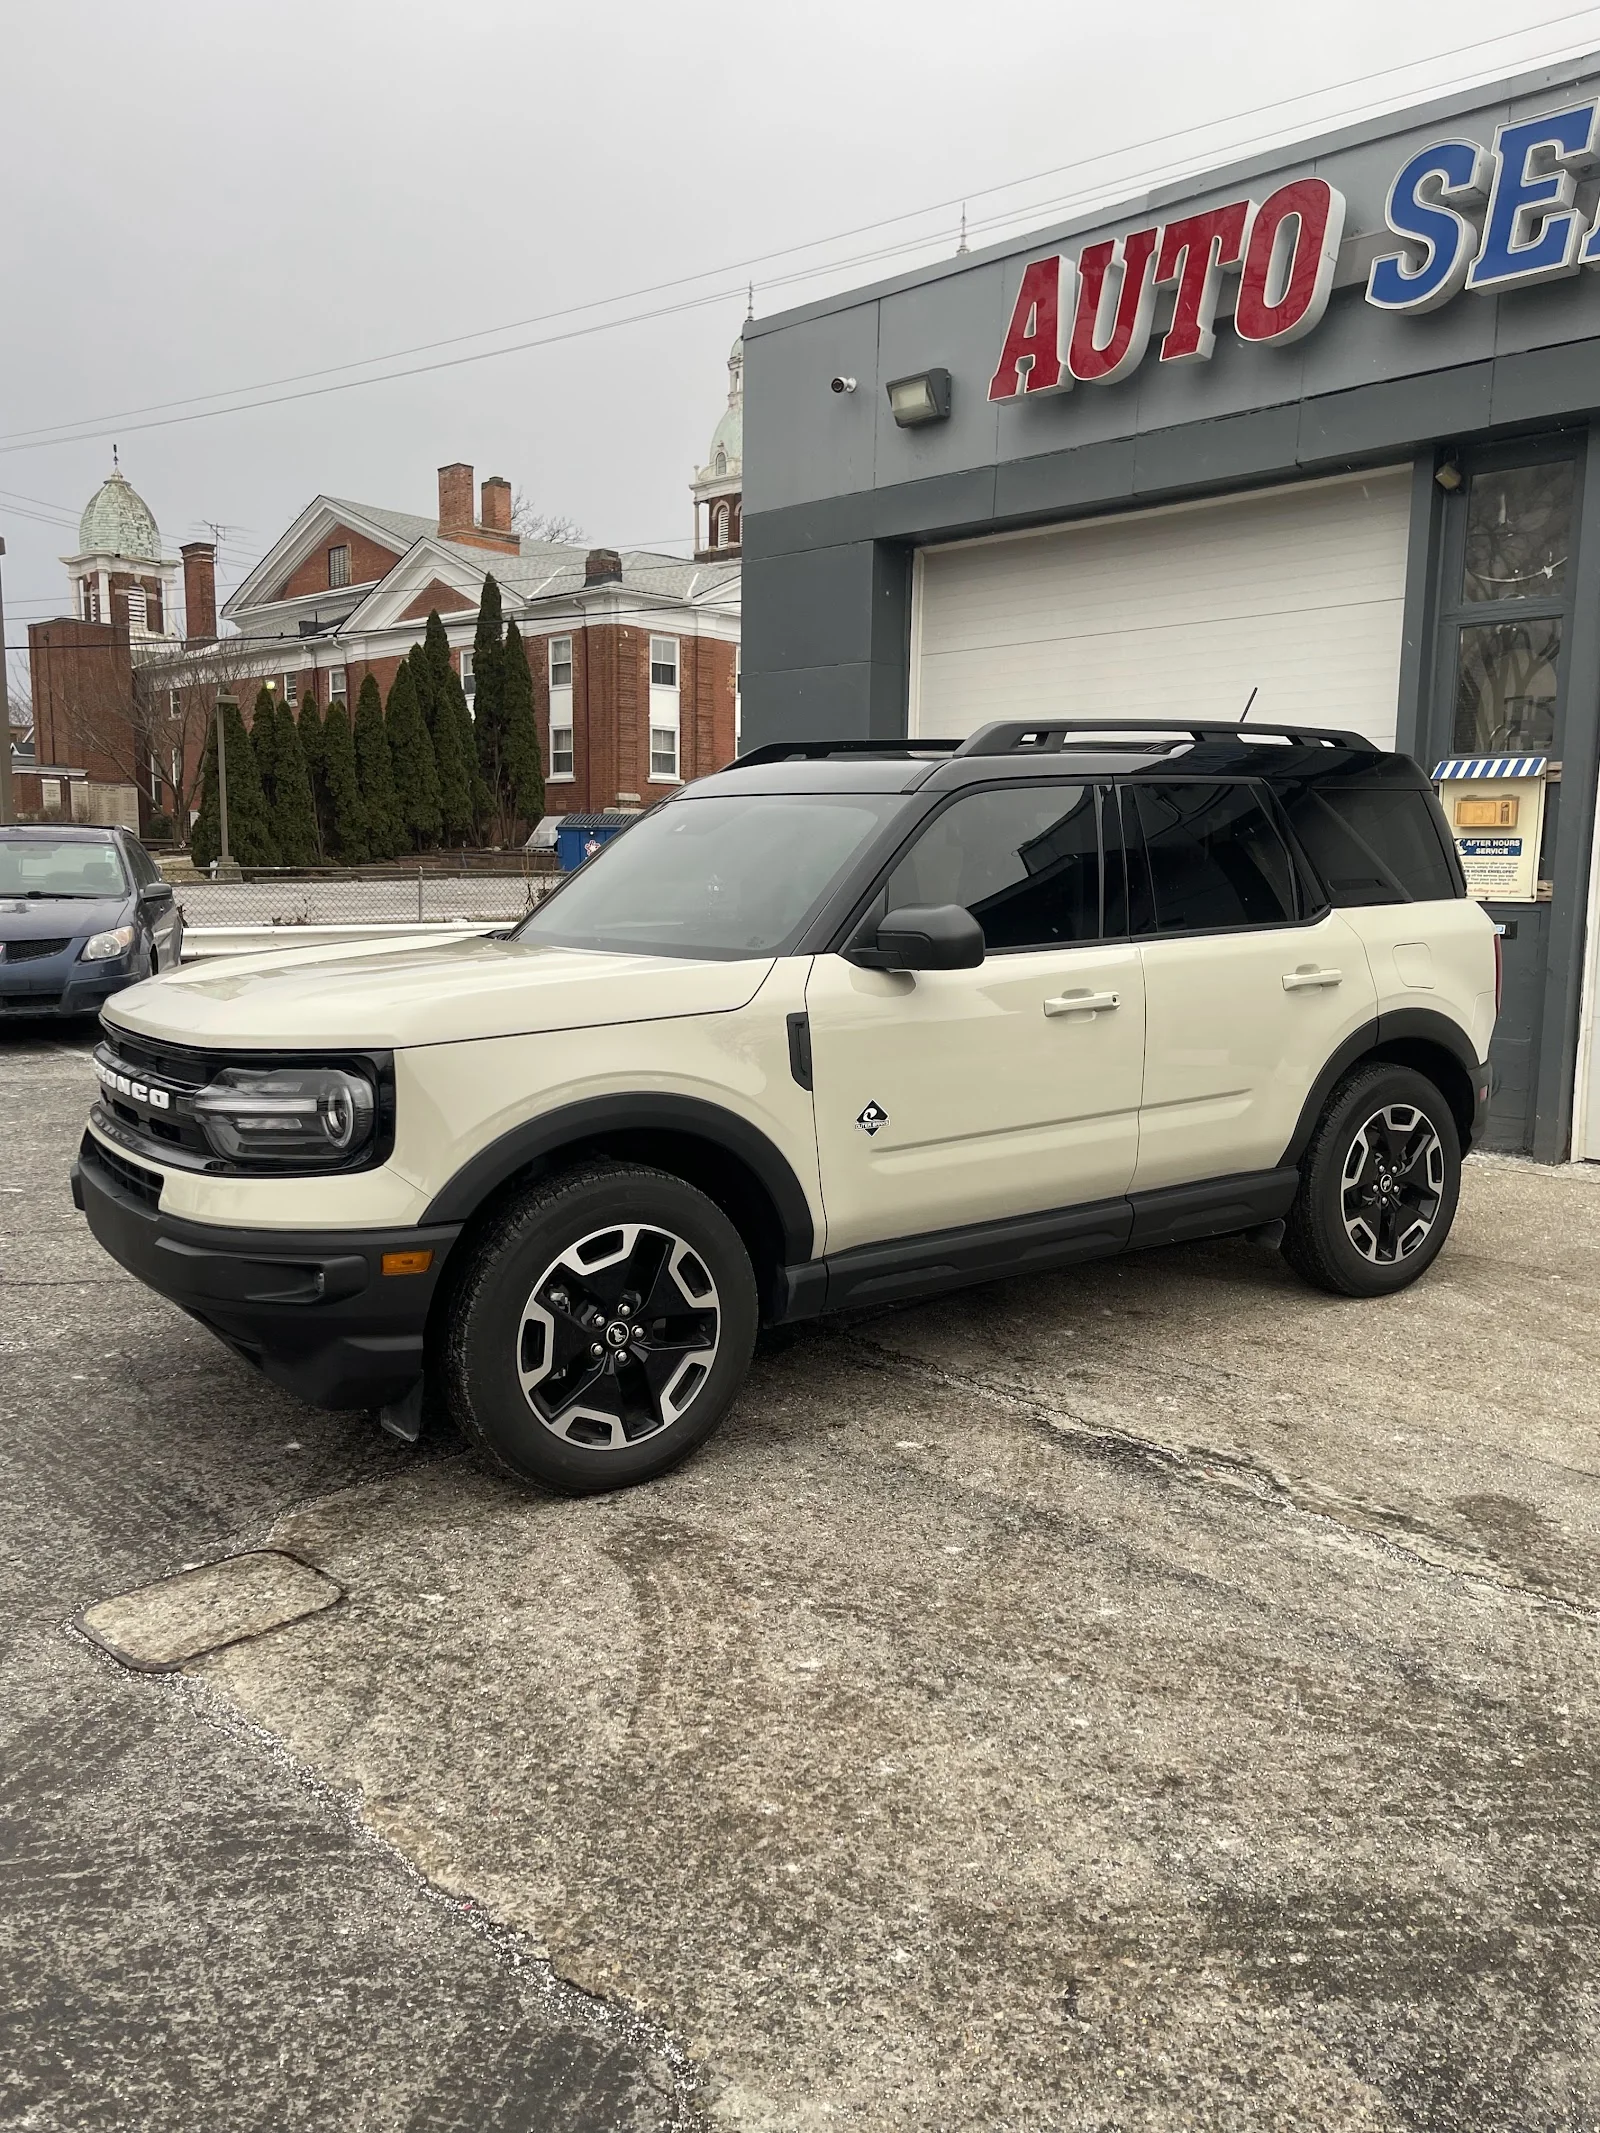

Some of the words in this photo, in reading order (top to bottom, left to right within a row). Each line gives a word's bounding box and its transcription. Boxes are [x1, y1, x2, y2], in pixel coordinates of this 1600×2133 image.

[987, 177, 1345, 404] AUTO
[1364, 96, 1600, 314] SE
[93, 1057, 170, 1110] ONCO
